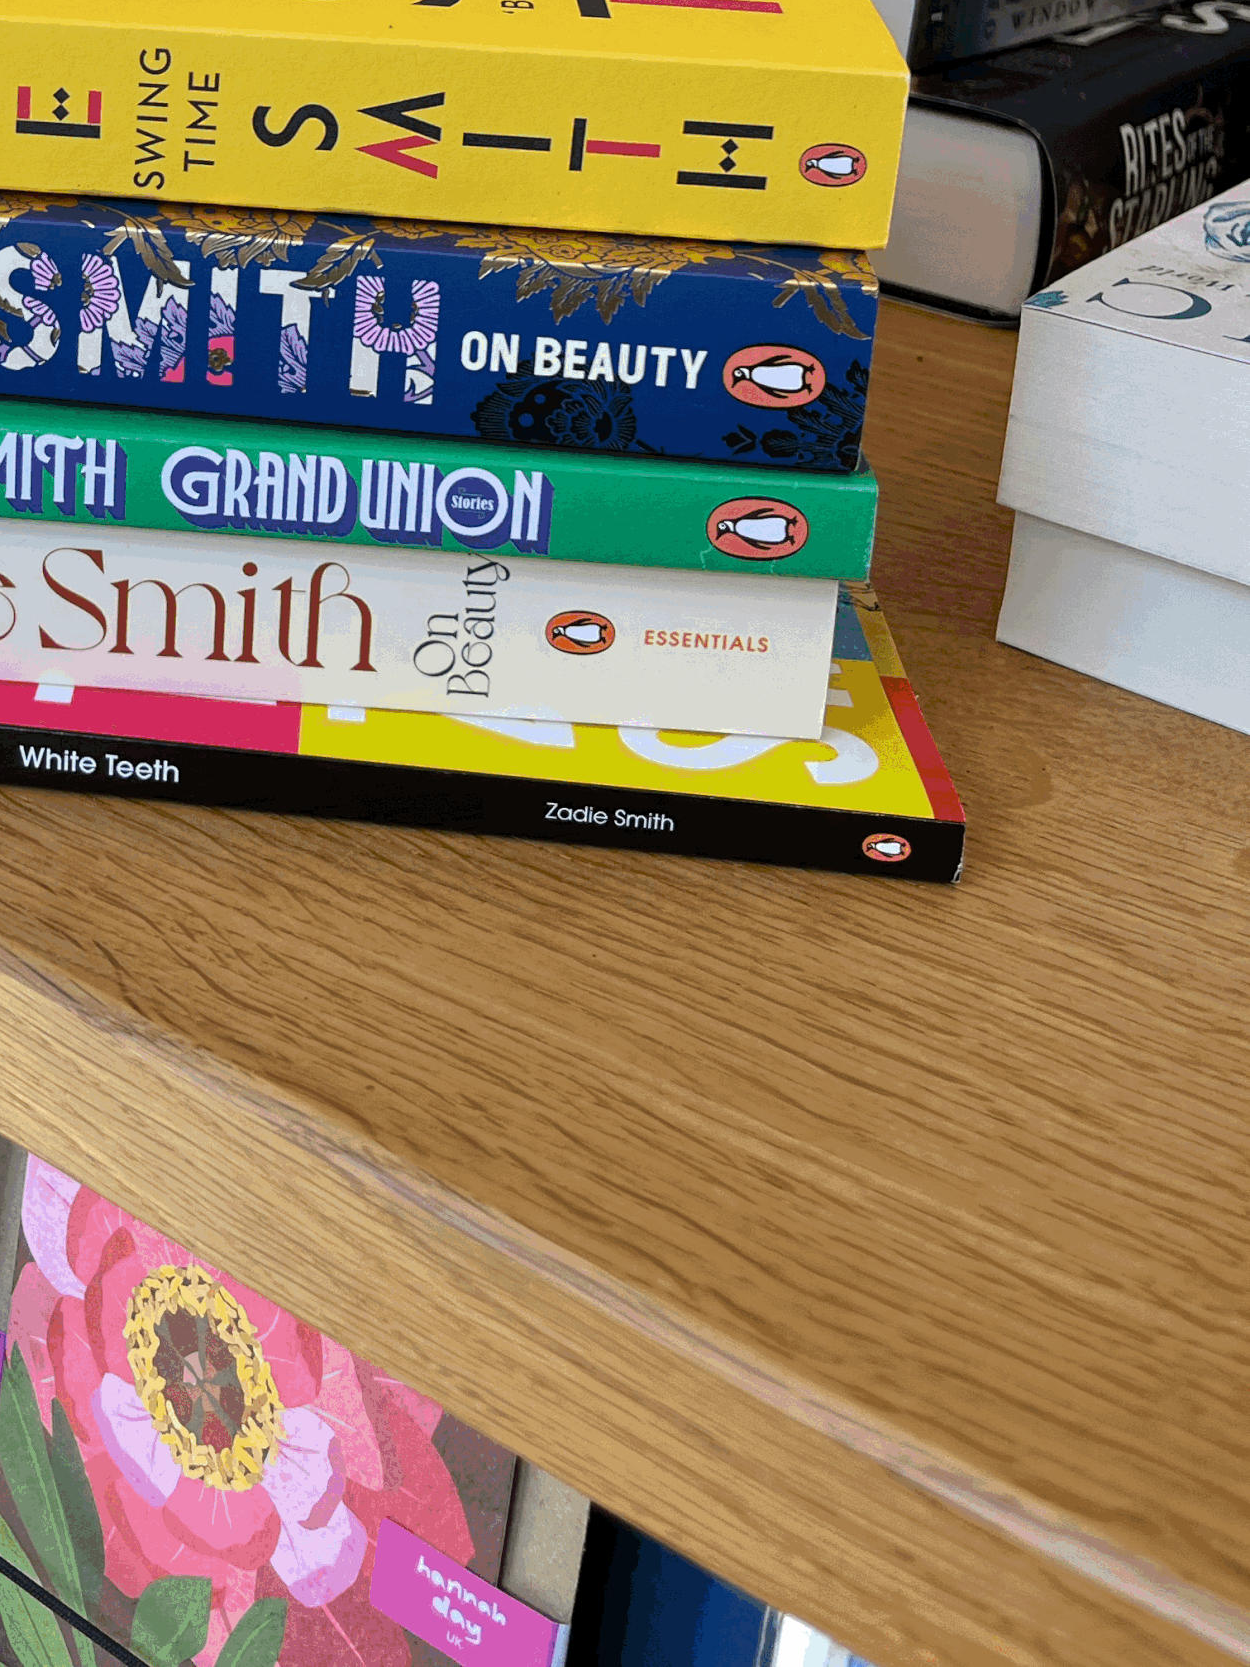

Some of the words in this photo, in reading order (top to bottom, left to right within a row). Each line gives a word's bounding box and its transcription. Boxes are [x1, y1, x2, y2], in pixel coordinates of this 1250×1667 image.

[133, 46, 172, 192] SWING
[183, 71, 221, 173] TIME
[252, 91, 775, 191] SMITH
[461, 330, 522, 374] ON
[534, 337, 709, 390] BEAUTY
[160, 445, 350, 529] GRAND
[359, 457, 548, 548] UNION
[451, 494, 495, 512] Stories
[38, 546, 378, 673] Smith
[446, 552, 510, 698] Beauty
[643, 628, 769, 654] ESSENTIALS
[413, 613, 459, 677] On
[19, 744, 97, 774] White
[104, 750, 180, 784] Teeth
[545, 802, 608, 827] Zadie
[613, 807, 674, 832] Smith
[416, 1554, 507, 1626] hannah
[431, 1595, 482, 1645] day
[446, 1630, 464, 1650] UK
